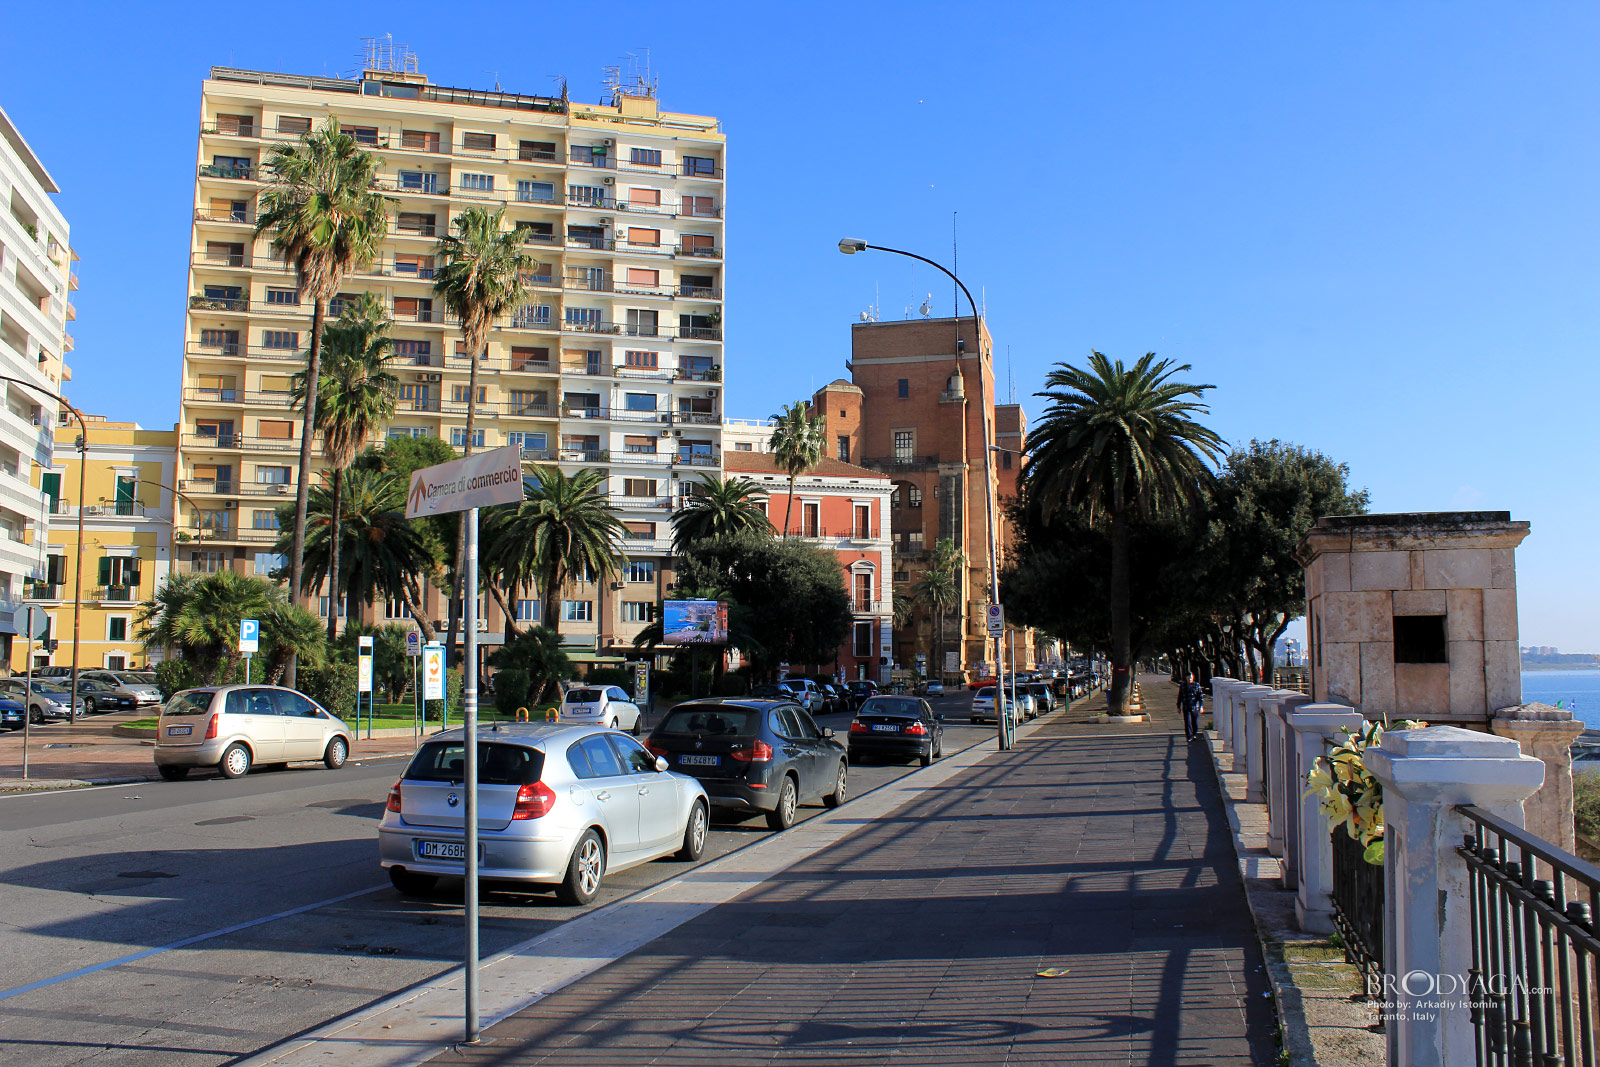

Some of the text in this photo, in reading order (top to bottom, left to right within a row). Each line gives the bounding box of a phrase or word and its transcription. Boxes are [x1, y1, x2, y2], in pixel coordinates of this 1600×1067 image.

[427, 465, 518, 498] Camera di commercio
[242, 621, 256, 639] P
[682, 755, 692, 764] EN
[425, 842, 466, 857] DM 268H
